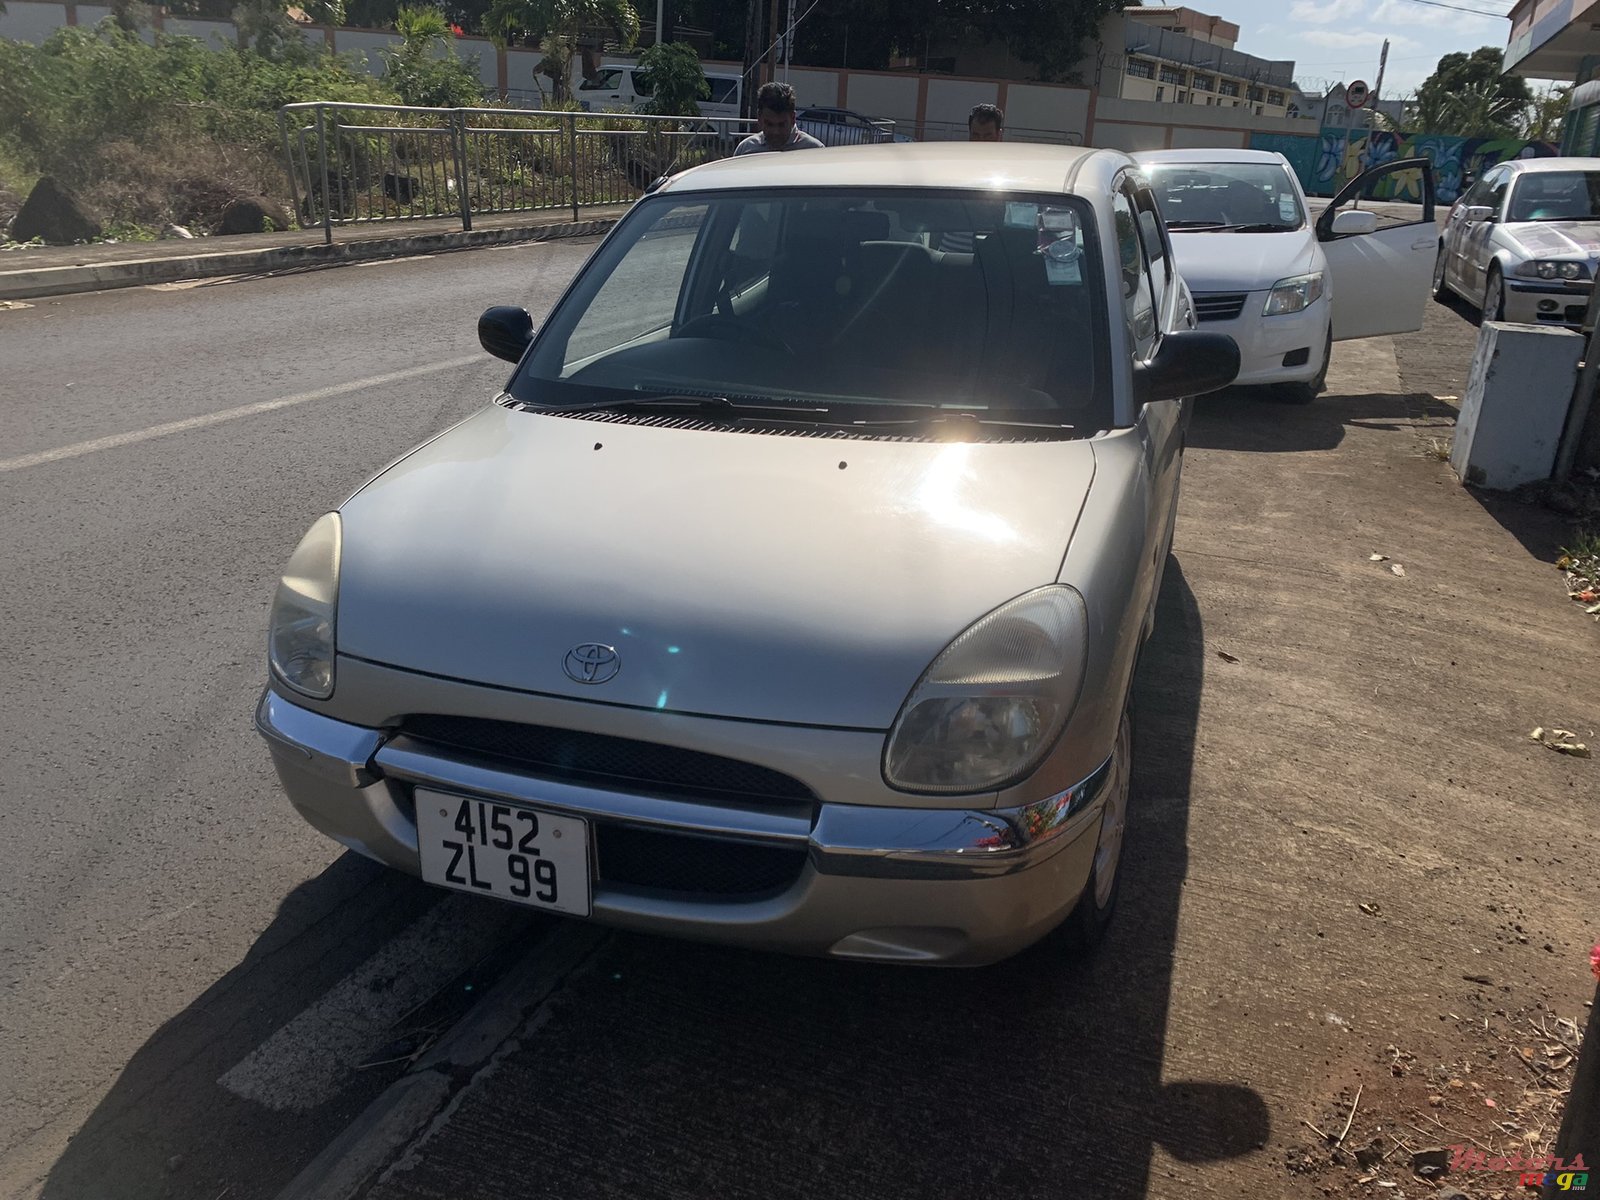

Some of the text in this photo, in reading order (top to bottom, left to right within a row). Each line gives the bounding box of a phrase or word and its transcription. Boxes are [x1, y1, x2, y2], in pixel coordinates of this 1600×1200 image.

[455, 800, 540, 856] 4152
[443, 840, 557, 903] ZL 99
